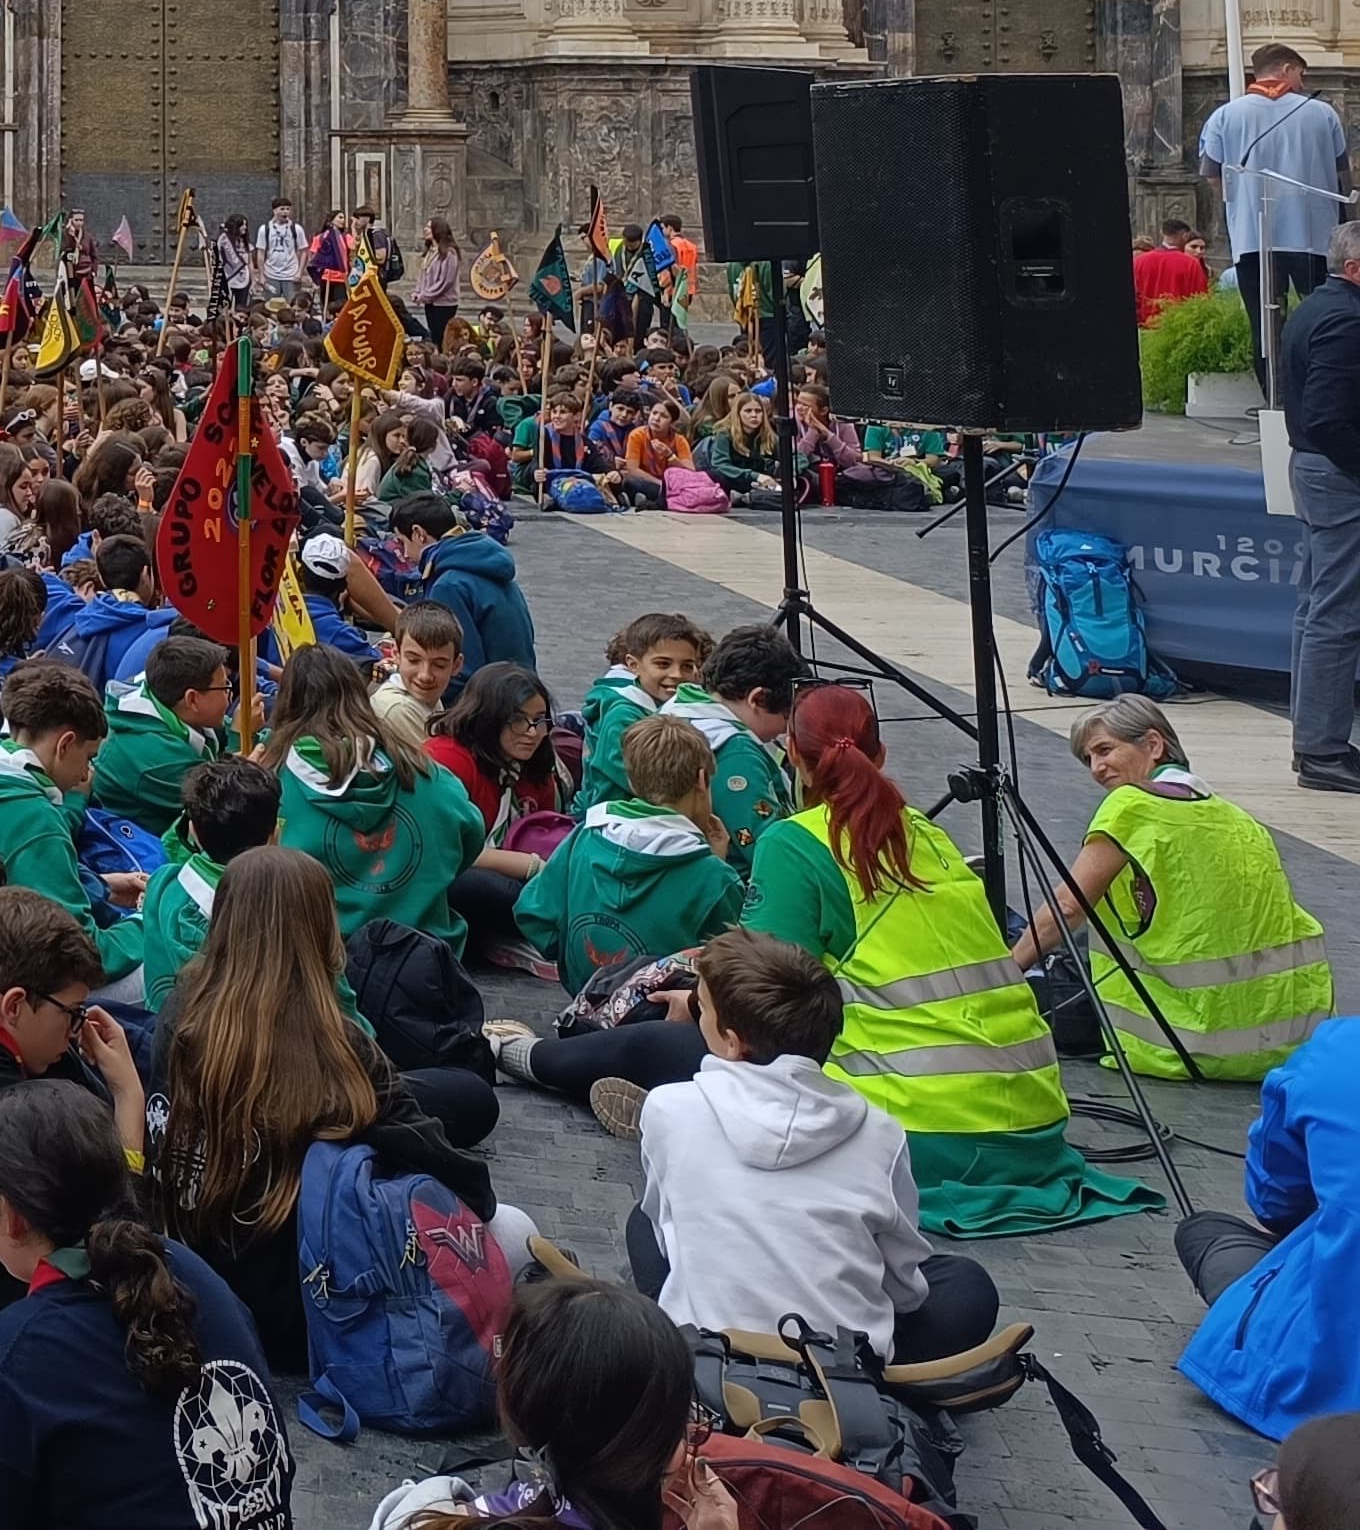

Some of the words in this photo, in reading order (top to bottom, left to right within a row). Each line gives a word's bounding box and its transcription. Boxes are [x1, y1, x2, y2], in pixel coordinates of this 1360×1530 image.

[348, 286, 377, 370] JAGUAR
[171, 477, 201, 598] GRUPO
[250, 544, 279, 621] FLOR
